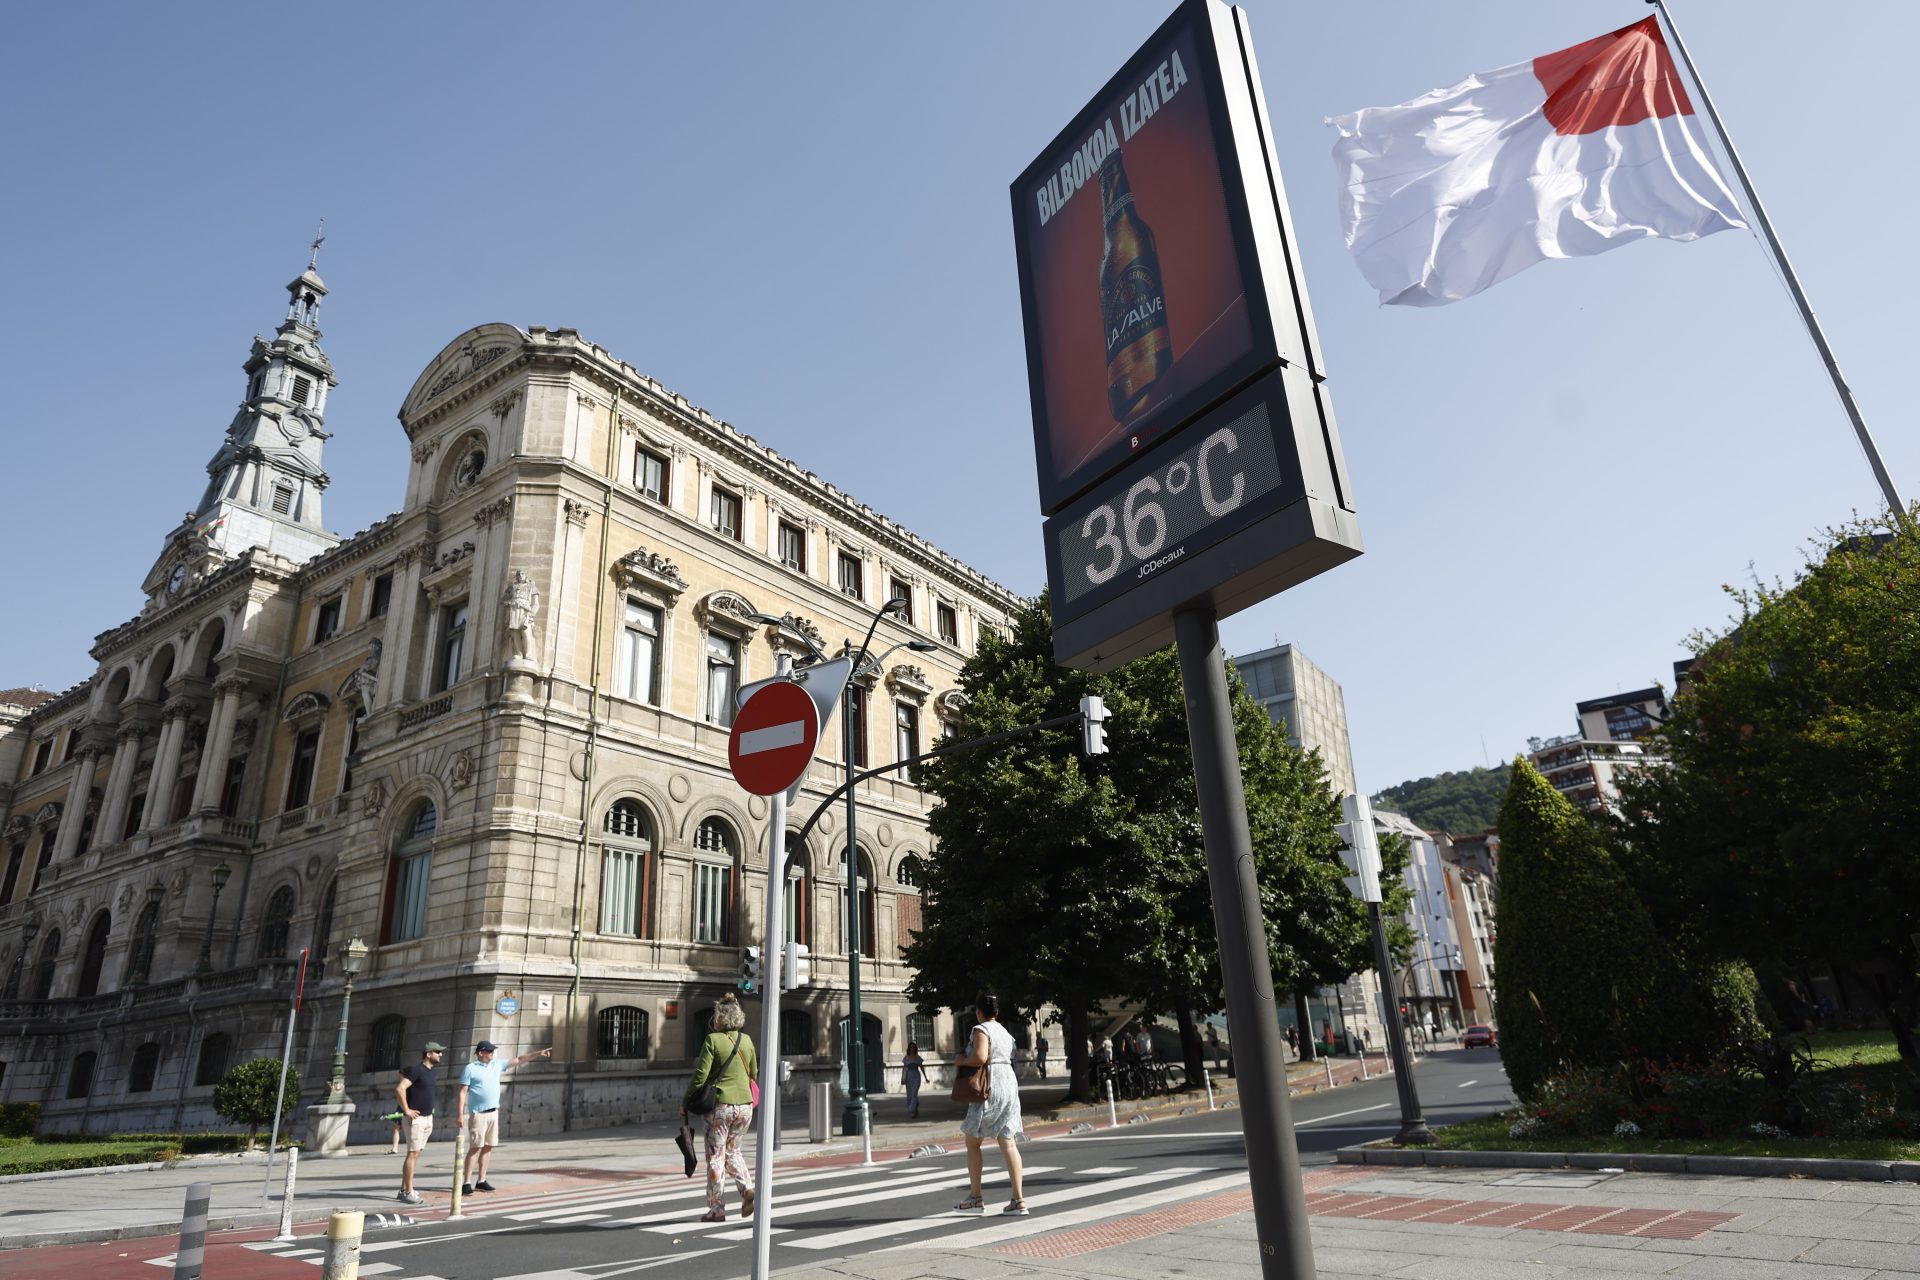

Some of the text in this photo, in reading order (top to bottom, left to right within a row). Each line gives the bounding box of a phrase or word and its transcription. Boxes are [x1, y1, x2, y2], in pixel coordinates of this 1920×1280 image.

[1036, 49, 1189, 227] BILBOKOA IZATEA
[1107, 327, 1120, 351] LA
[1131, 436, 1139, 448] B
[1081, 427, 1245, 585] 36°C
[1137, 546, 1186, 579] JCDecaux
